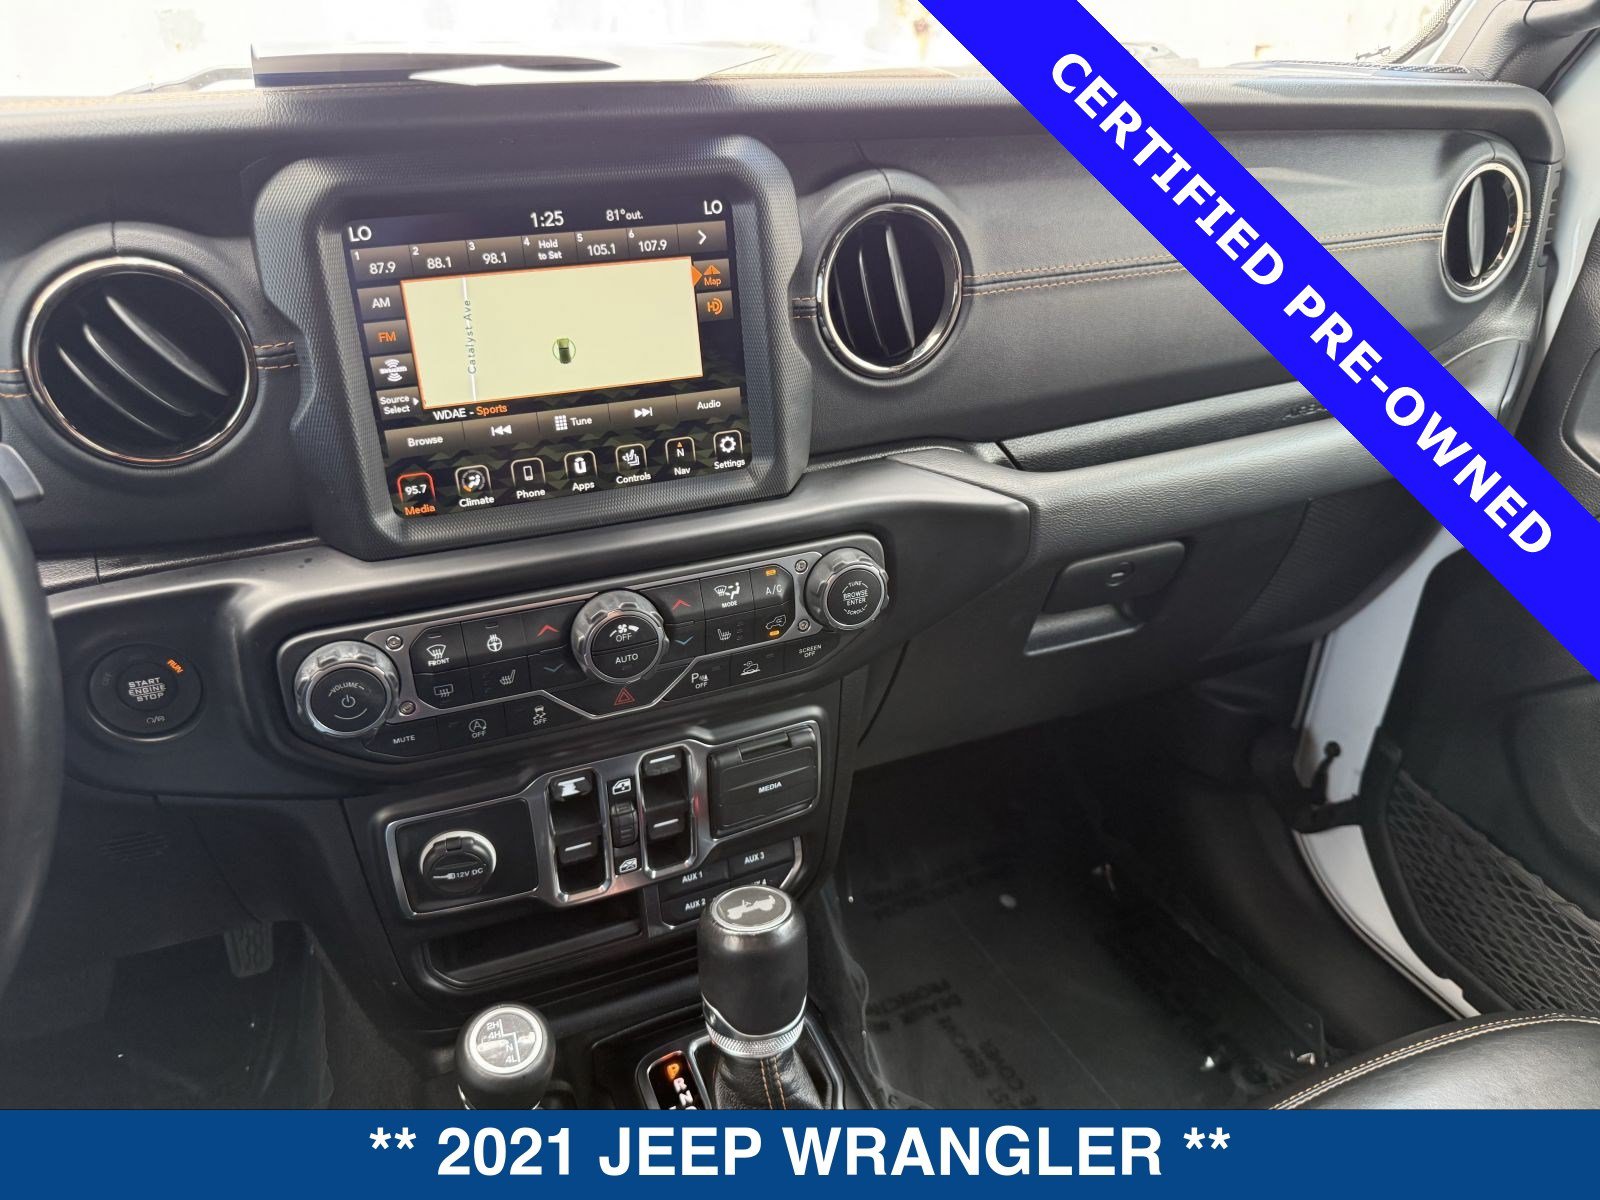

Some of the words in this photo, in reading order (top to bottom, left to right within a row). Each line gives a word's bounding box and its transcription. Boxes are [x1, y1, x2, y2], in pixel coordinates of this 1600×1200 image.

[703, 199, 723, 215] LO
[530, 211, 564, 228] 1:25
[348, 225, 372, 242] LO
[576, 233, 583, 243] 5
[628, 229, 635, 239] 6
[468, 242, 476, 251] 3
[523, 237, 530, 247] 4
[538, 239, 558, 249] Hold
[638, 239, 668, 252] 107.9
[354, 251, 360, 261] 1
[412, 246, 419, 256] 2
[538, 252, 546, 260] to
[548, 250, 562, 260] Set
[587, 243, 616, 257] 105.1
[426, 256, 452, 270] 88.1
[482, 251, 507, 265] 98.1
[369, 261, 396, 275] 87.9
[703, 277, 722, 287] Map
[372, 296, 391, 309] AM
[463, 299, 472, 321] Ave
[378, 331, 397, 343] FM
[465, 321, 477, 374] Catalyst
[380, 395, 410, 406] Source
[697, 399, 721, 411] Audio
[384, 404, 410, 415] Select
[433, 407, 467, 421] WDAE
[475, 404, 508, 417] Sports
[569, 416, 593, 427] Tune
[407, 435, 444, 447] Browse
[714, 458, 746, 470] Settings
[674, 466, 691, 476] Nav
[616, 472, 652, 485] Controls
[404, 484, 427, 496] 95.7
[572, 481, 595, 492] Apps
[516, 489, 546, 500] Phone
[459, 496, 495, 508] Climate
[404, 504, 436, 516] Media
[766, 585, 783, 596] A/C
[843, 588, 869, 600] BROWSE
[721, 600, 738, 609] MODE
[846, 597, 866, 607] ENTER
[615, 633, 633, 643] OFF
[798, 644, 822, 655] SCREEN
[803, 651, 816, 659] OFF
[427, 657, 450, 667] FRONT
[615, 653, 639, 665] AUTO
[128, 676, 161, 689] START
[331, 681, 359, 694] VOLUME
[695, 681, 708, 690] OFF
[128, 684, 167, 697] ENGINE
[136, 692, 165, 703] STOP
[533, 717, 547, 726] OFF
[393, 735, 416, 745] MUTE
[471, 730, 486, 739] OFF
[758, 781, 783, 794] MEDIA
[744, 853, 757, 865] AUX
[757, 851, 765, 861] 3
[456, 869, 470, 879] 12V
[471, 867, 484, 876] DC
[682, 872, 698, 884] AUX
[685, 899, 700, 911] AUX
[486, 1021, 500, 1031] 2H
[487, 1030, 502, 1039] 4H
[666, 1063, 680, 1079] P
[673, 1077, 687, 1093] R
[679, 1090, 694, 1106] N
